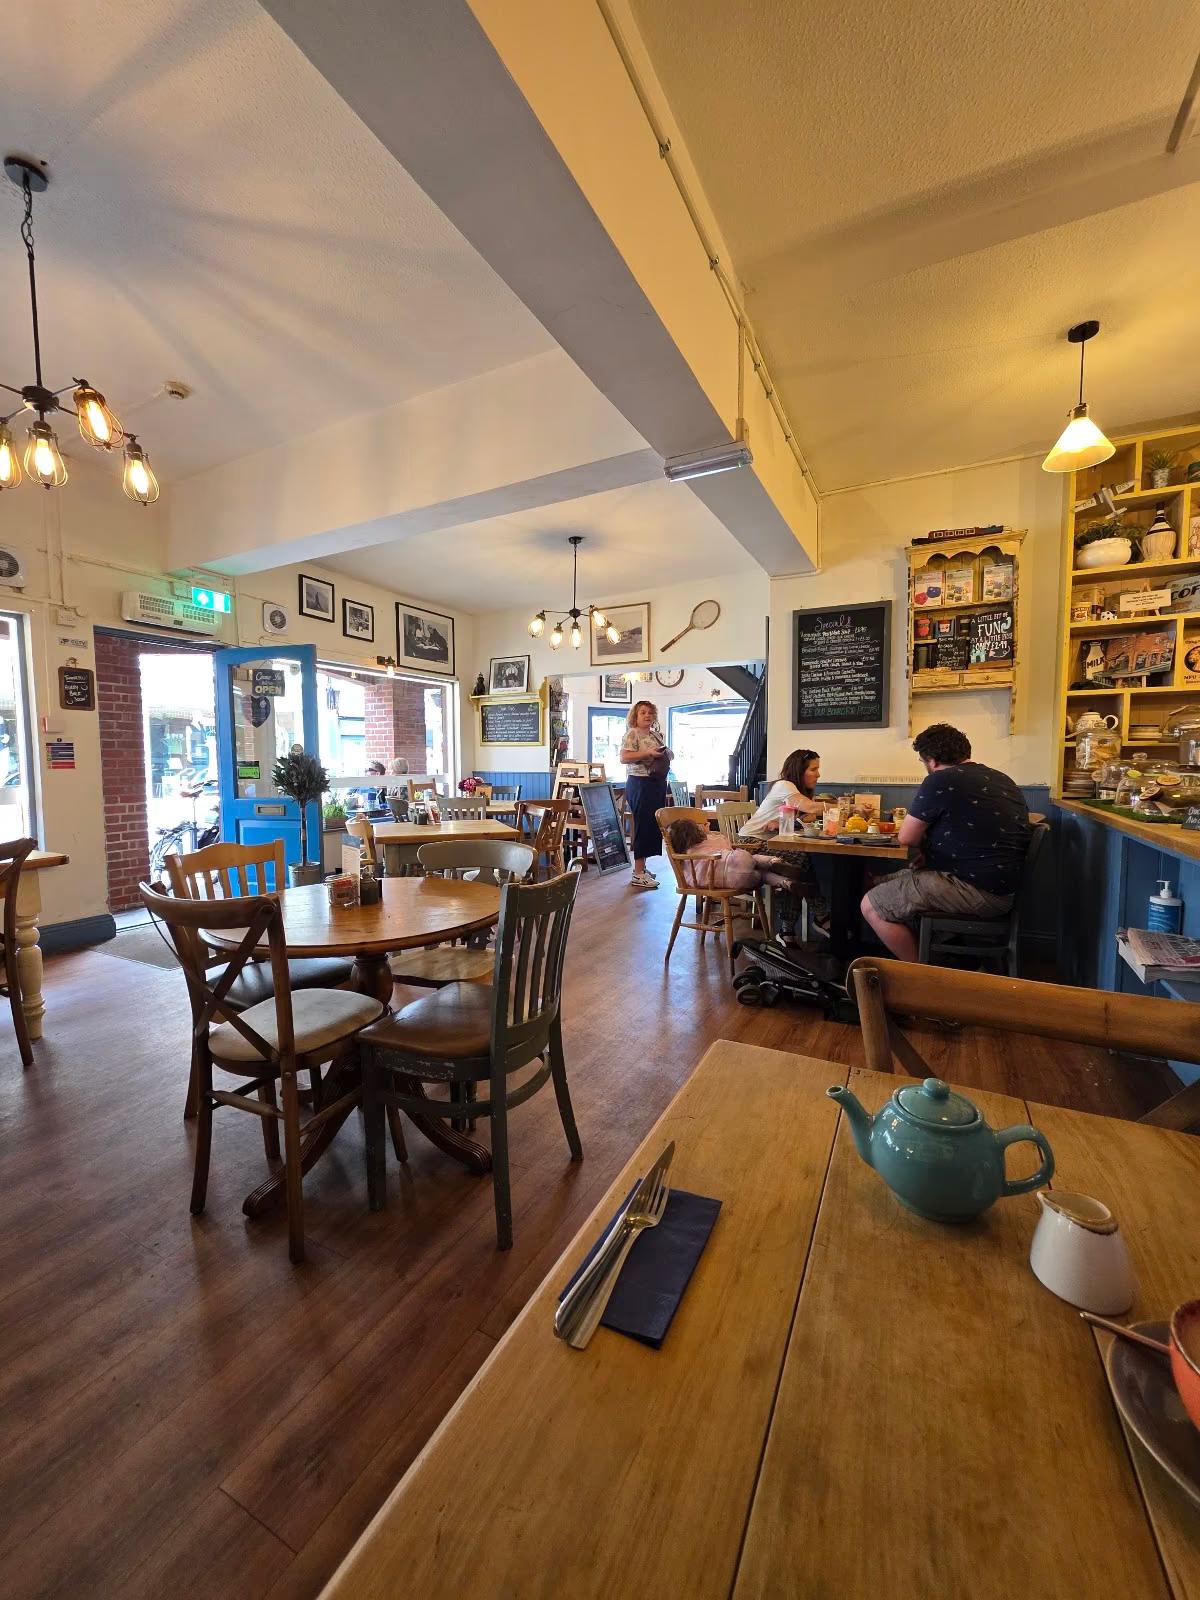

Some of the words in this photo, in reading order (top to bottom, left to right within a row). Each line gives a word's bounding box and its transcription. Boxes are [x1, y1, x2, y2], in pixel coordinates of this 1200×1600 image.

[977, 620, 1001, 637] FUN
[1086, 656, 1105, 669] MILK
[255, 685, 282, 694] OPEN
